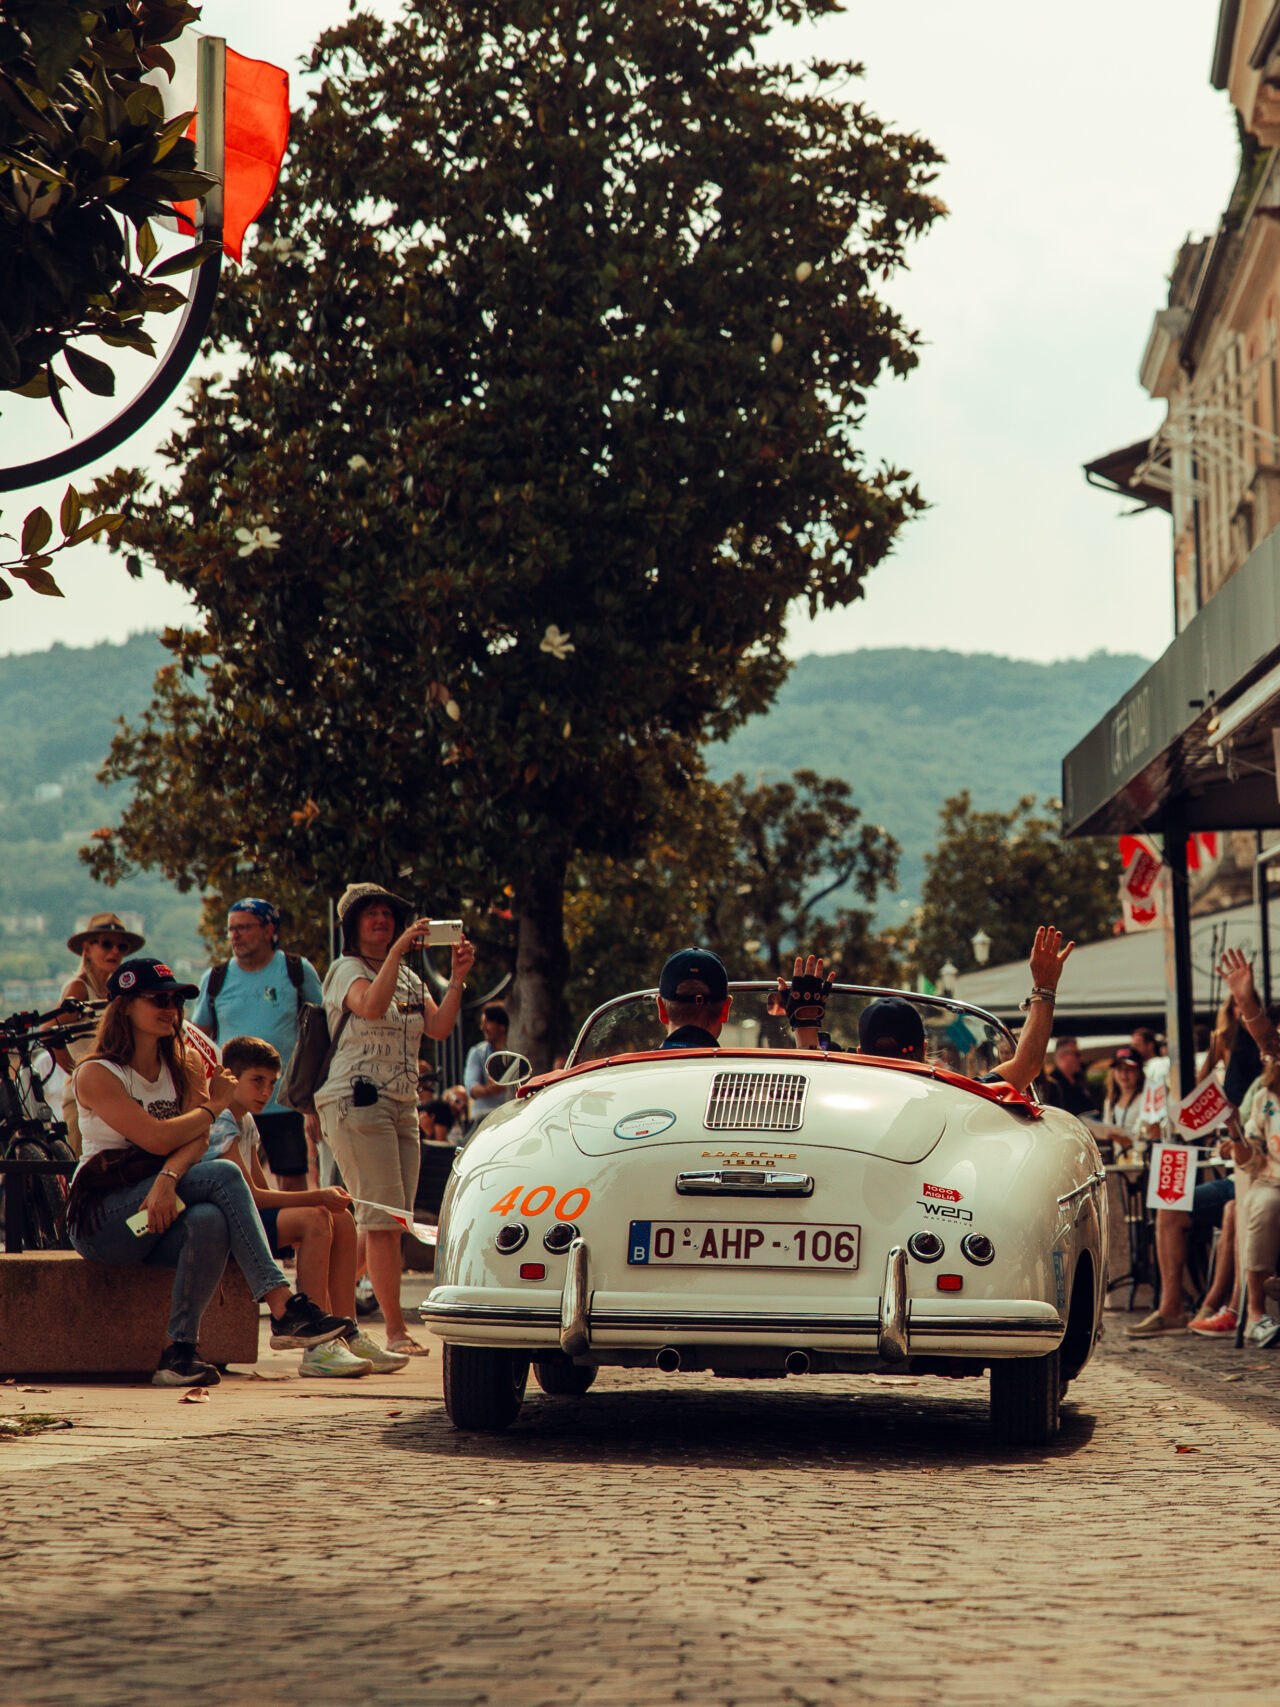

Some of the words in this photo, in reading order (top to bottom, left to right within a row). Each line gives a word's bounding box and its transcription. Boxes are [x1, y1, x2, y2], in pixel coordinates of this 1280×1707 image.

[1188, 1089, 1216, 1116] 1000
[701, 1151, 797, 1159] PORSCHE
[722, 1159, 776, 1167] 1500
[1161, 1153, 1174, 1190] 1000
[925, 1191, 955, 1201] MIGLIA
[926, 1185, 954, 1195] 1000
[489, 1186, 591, 1221] 400
[634, 1246, 646, 1261] B
